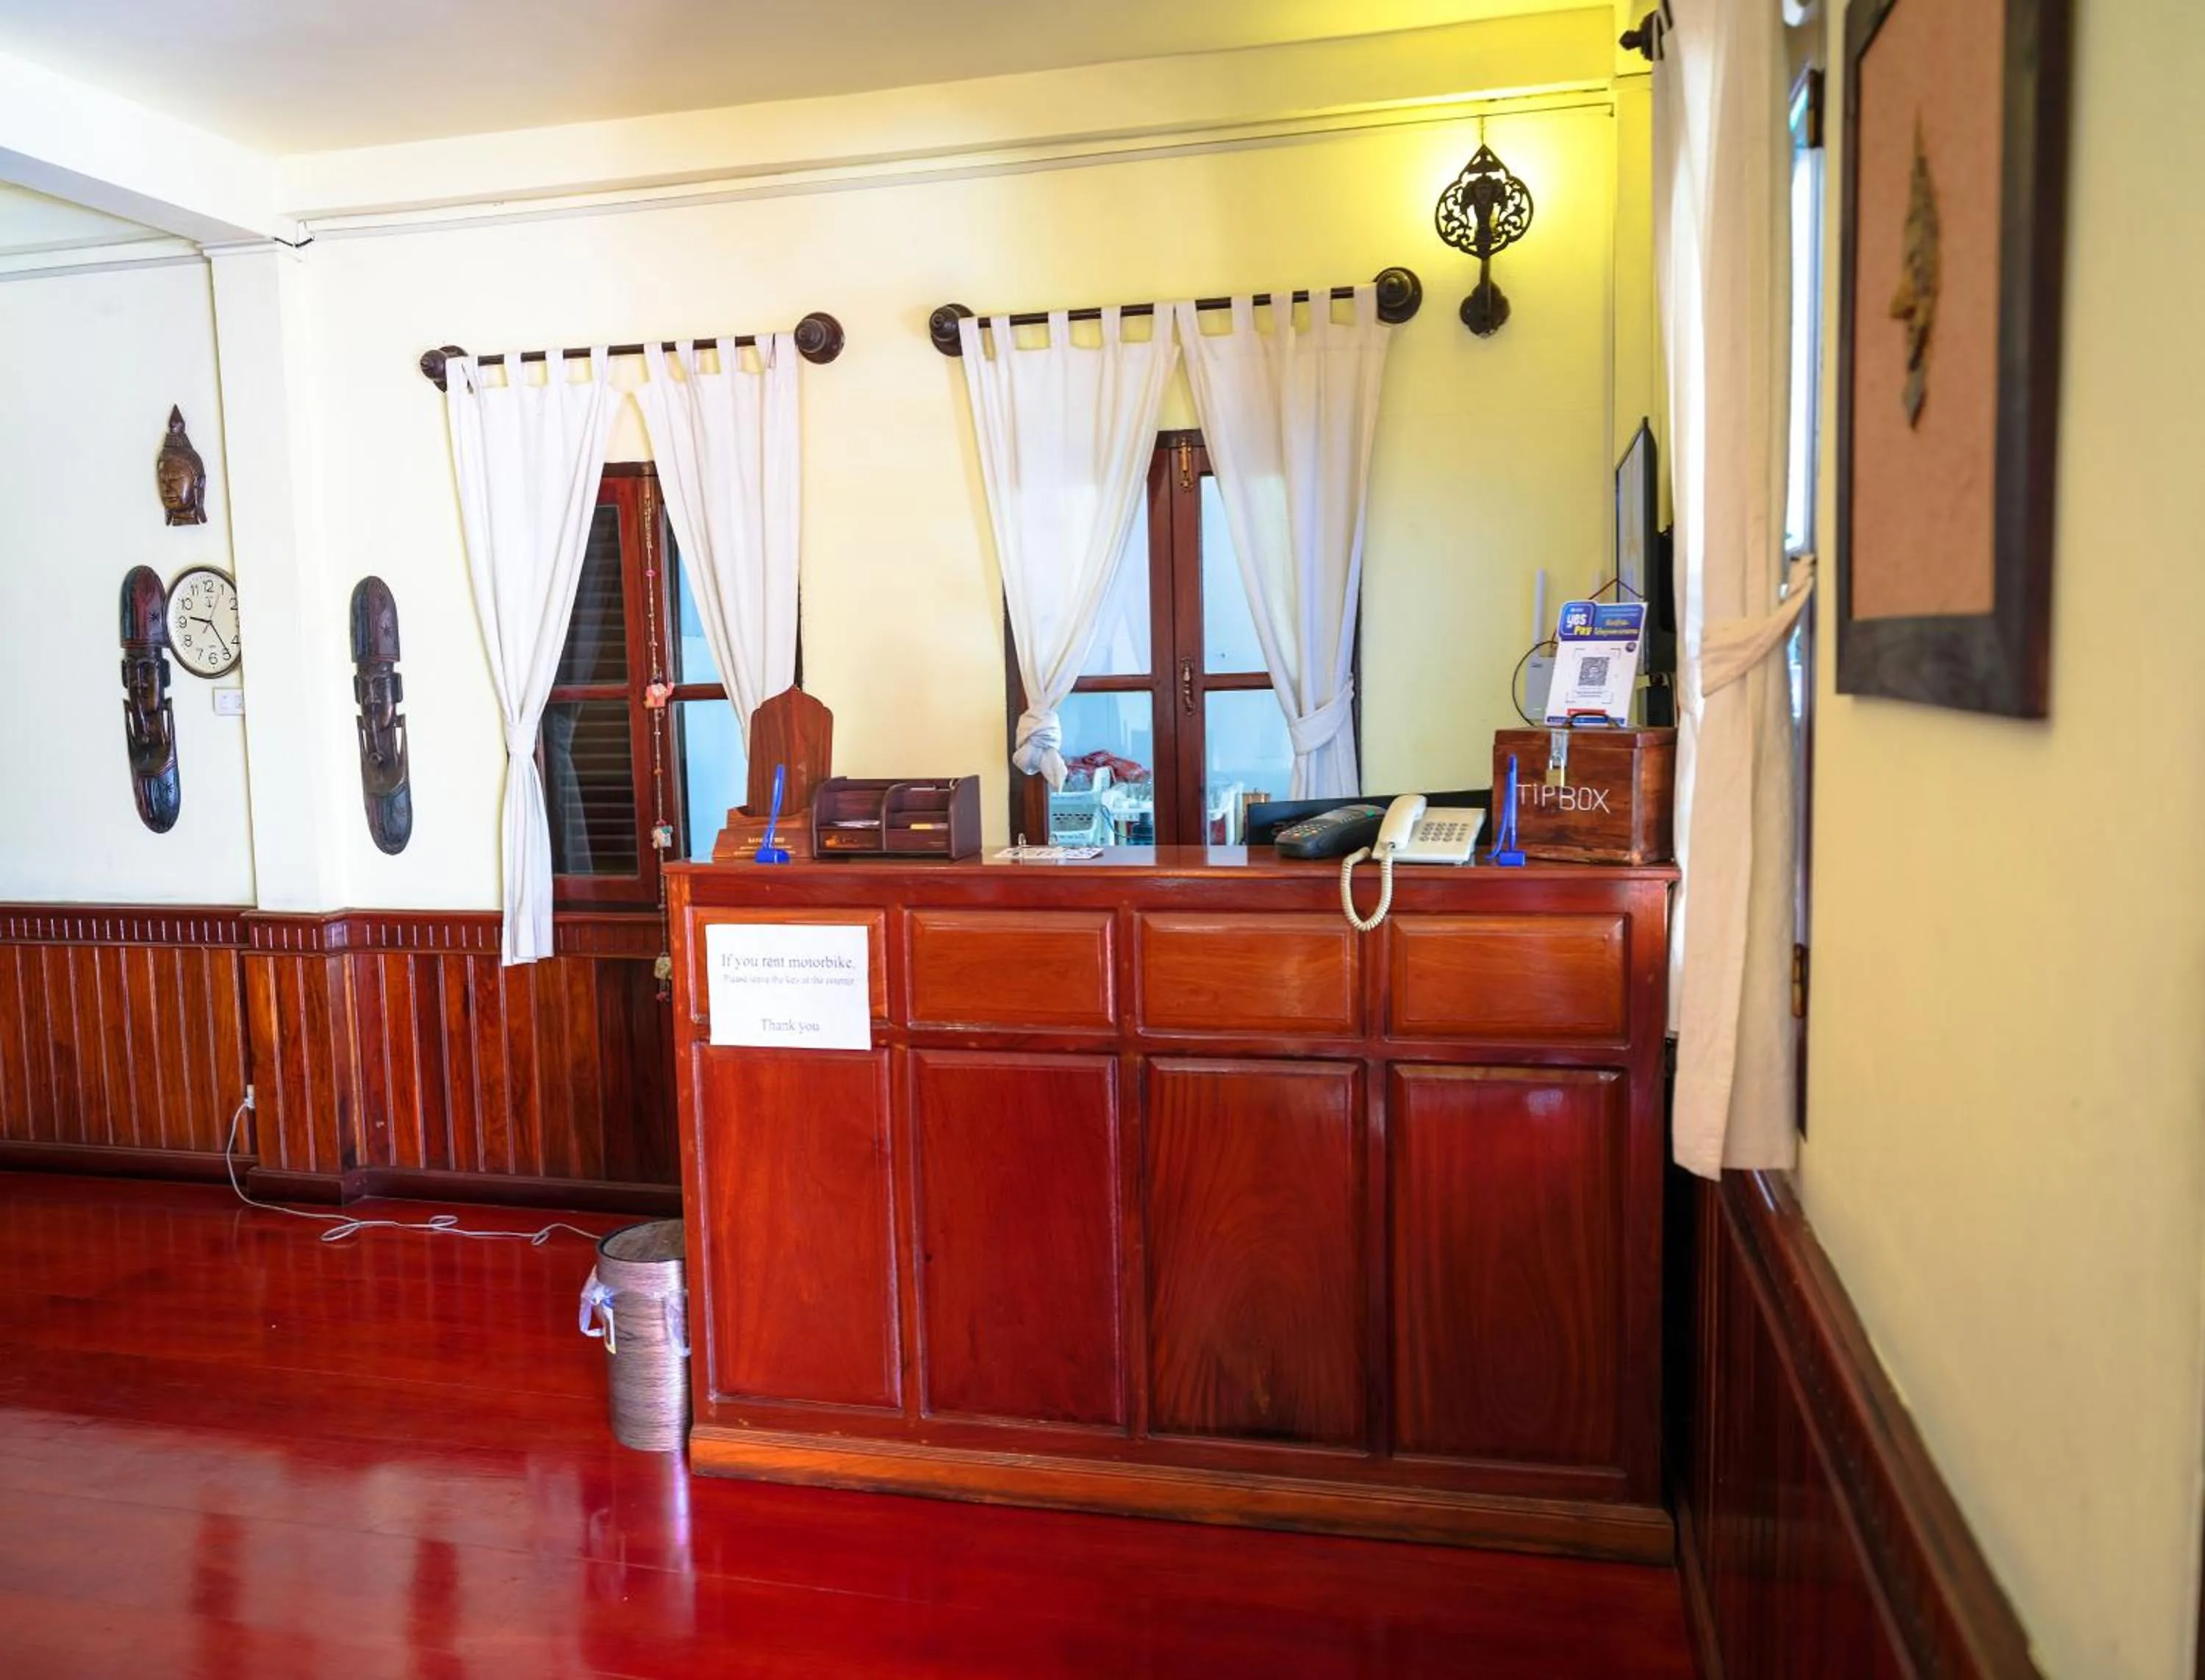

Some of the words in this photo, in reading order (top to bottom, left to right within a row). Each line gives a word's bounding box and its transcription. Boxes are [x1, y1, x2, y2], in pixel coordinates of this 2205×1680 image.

[190, 584, 200, 596] 11
[202, 579, 215, 593] 12
[220, 583, 225, 596] 1
[181, 597, 193, 611] 10
[229, 597, 239, 611] 2
[178, 616, 187, 628] 9
[184, 633, 193, 647] 8
[230, 634, 240, 645] 4
[196, 648, 204, 661] 7
[208, 652, 219, 665] 6
[721, 953, 734, 968] If
[735, 957, 759, 971] you
[761, 955, 785, 969] rent
[761, 1018, 795, 1033] Thank
[798, 1021, 820, 1034] you
